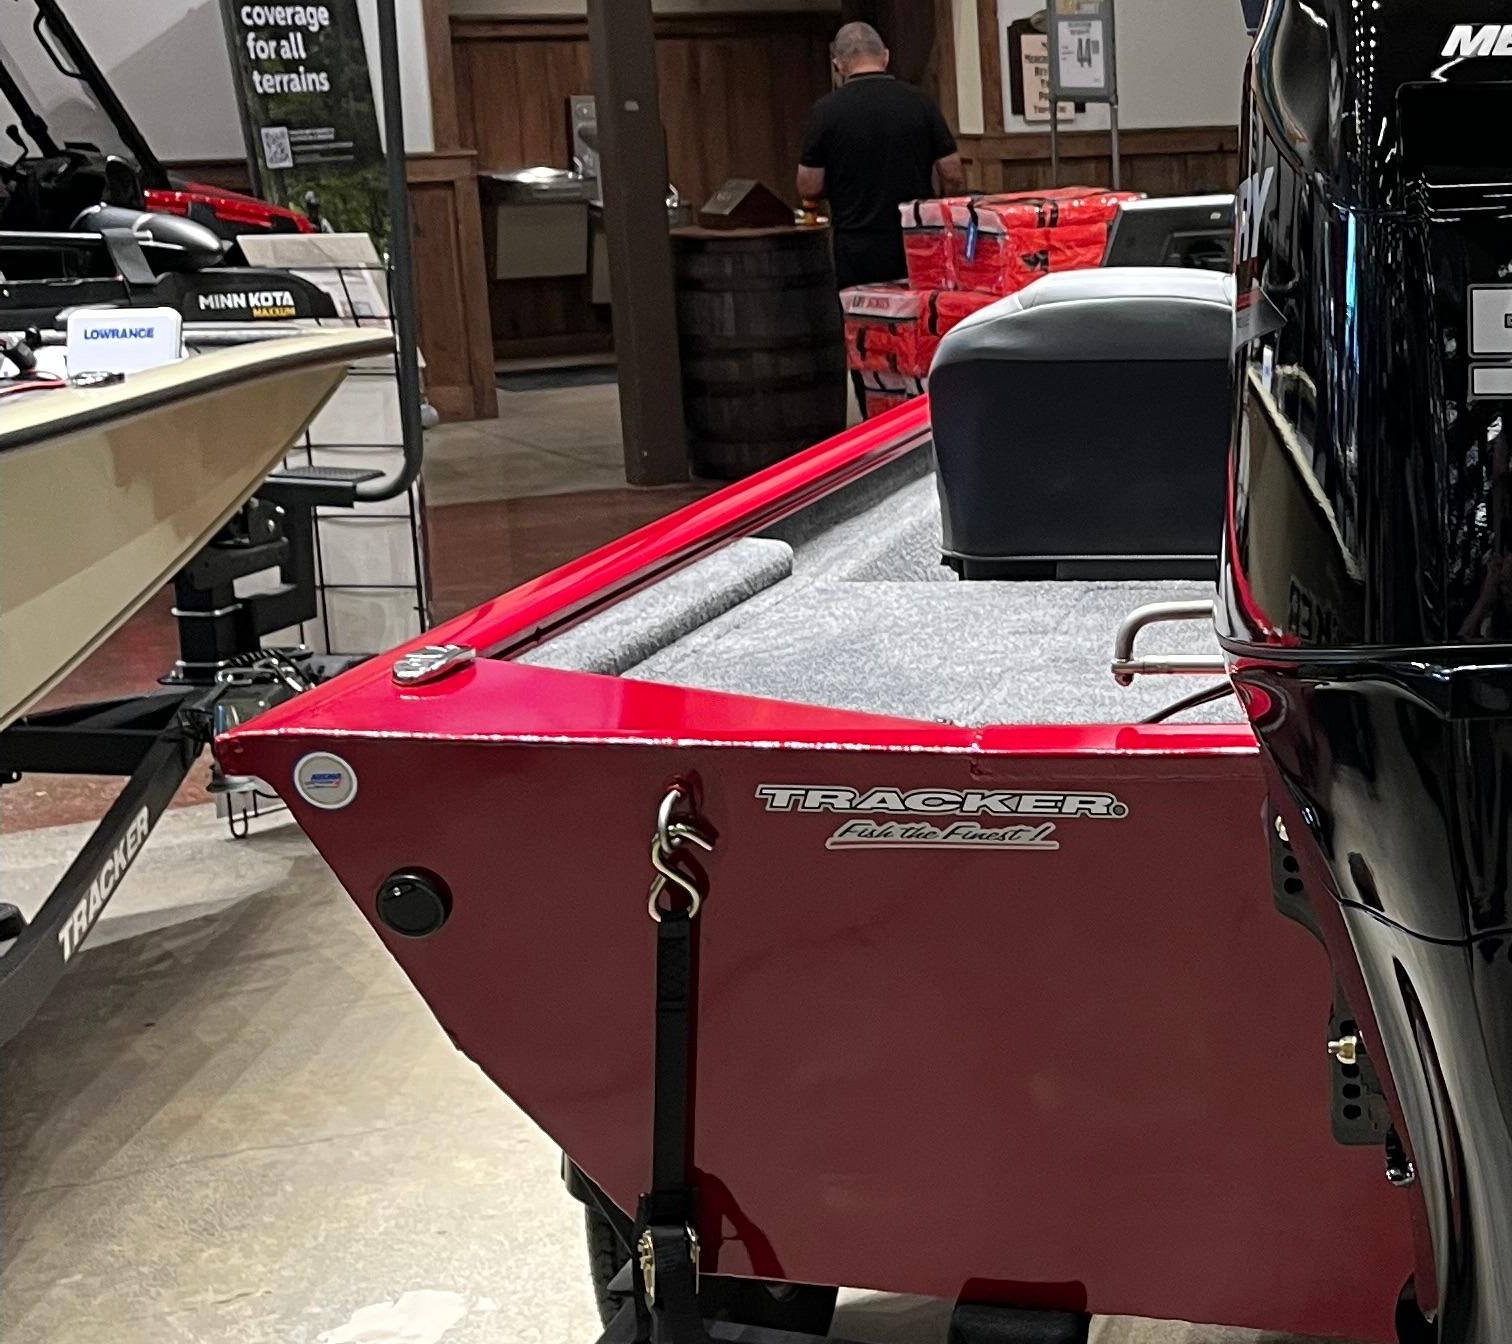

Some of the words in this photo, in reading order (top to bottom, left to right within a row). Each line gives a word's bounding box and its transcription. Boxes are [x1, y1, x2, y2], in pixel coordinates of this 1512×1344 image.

[241, 5, 330, 32] coverage
[246, 32, 277, 60] for
[280, 31, 307, 59] all
[252, 65, 330, 94] terrains
[198, 293, 247, 310] MINN
[248, 291, 295, 307] KOTA
[84, 328, 154, 340] LOWRANCE
[756, 786, 1118, 816] TRACKER
[838, 822, 894, 839] Fish
[895, 824, 938, 840] the
[58, 806, 149, 964] TRACKER
